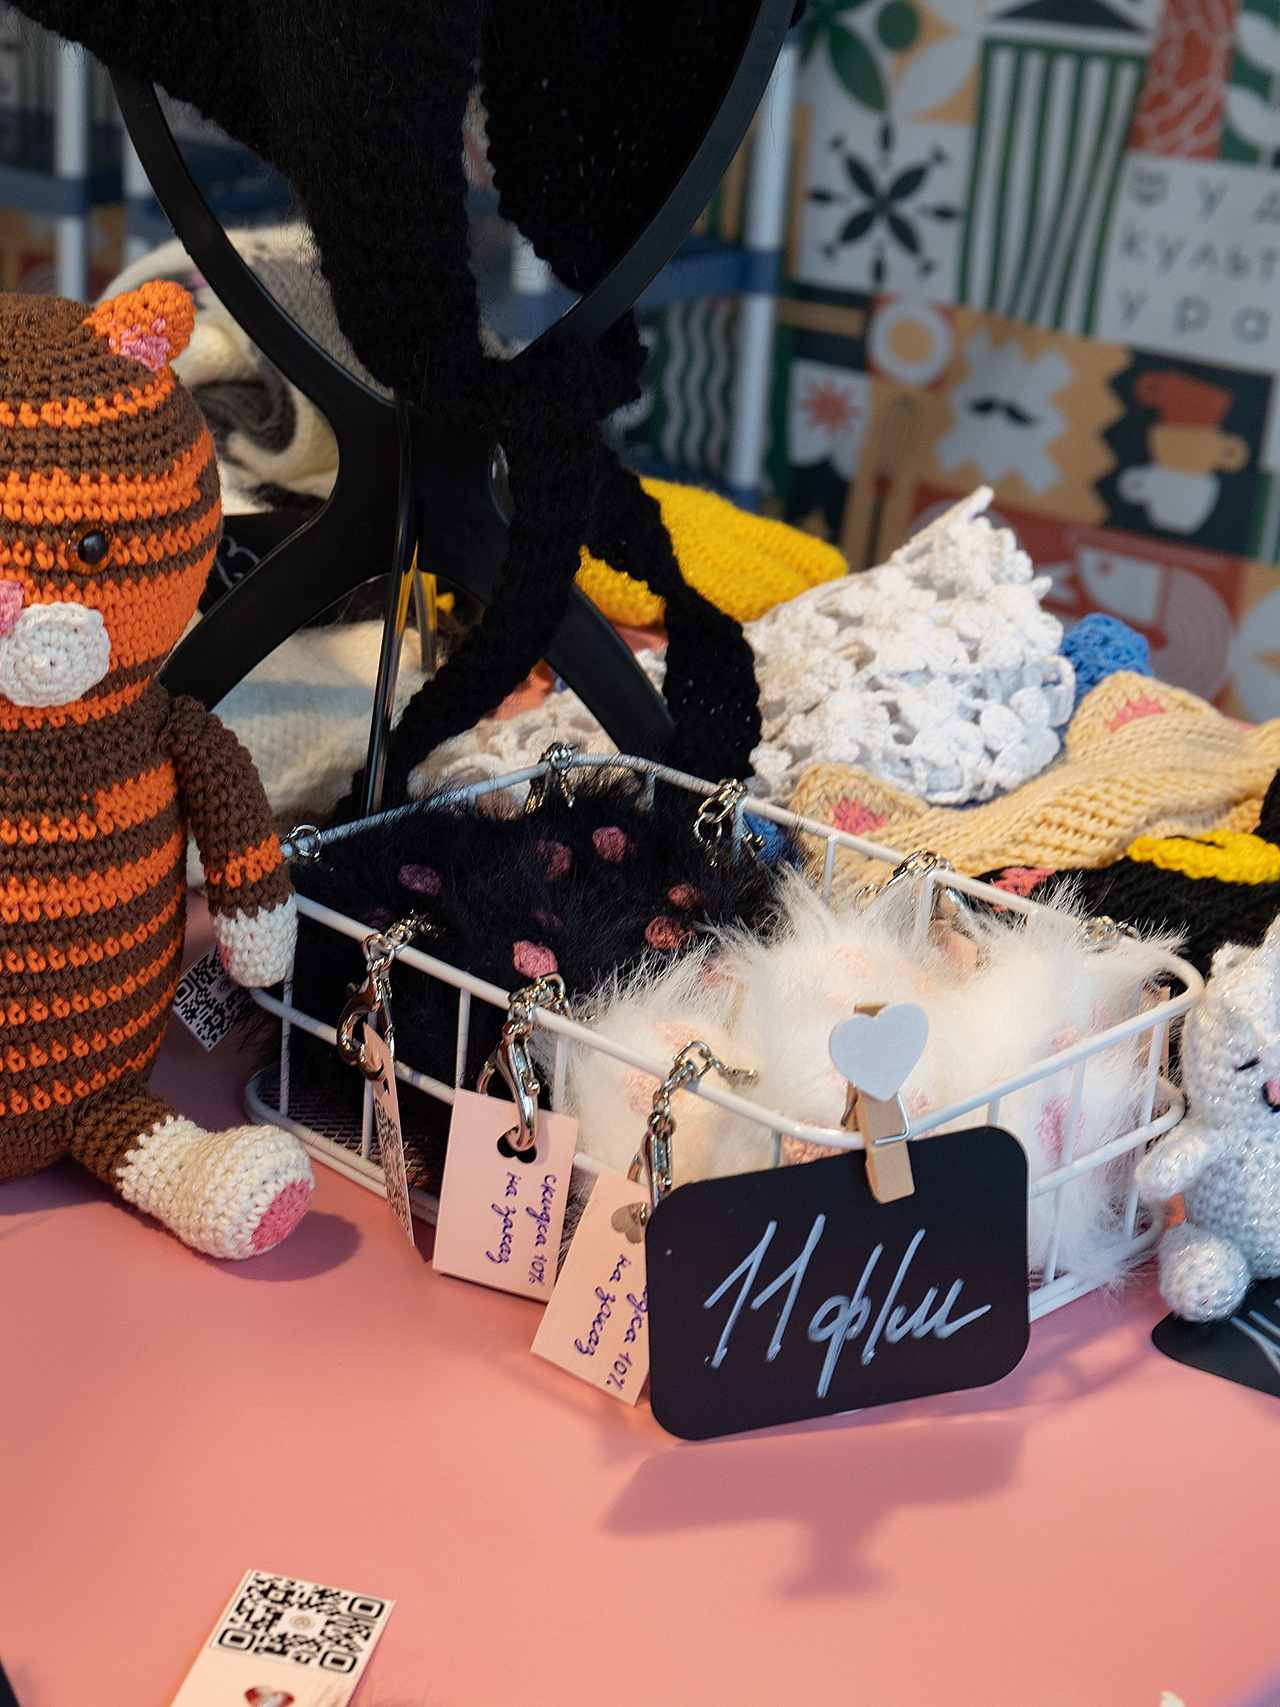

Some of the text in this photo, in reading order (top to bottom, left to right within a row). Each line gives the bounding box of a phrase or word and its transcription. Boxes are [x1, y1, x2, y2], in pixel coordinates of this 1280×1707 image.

[486, 1171, 522, 1265] на заказ
[526, 1173, 558, 1248] скидка
[574, 1253, 632, 1357] на заказ
[703, 1213, 826, 1368] 11
